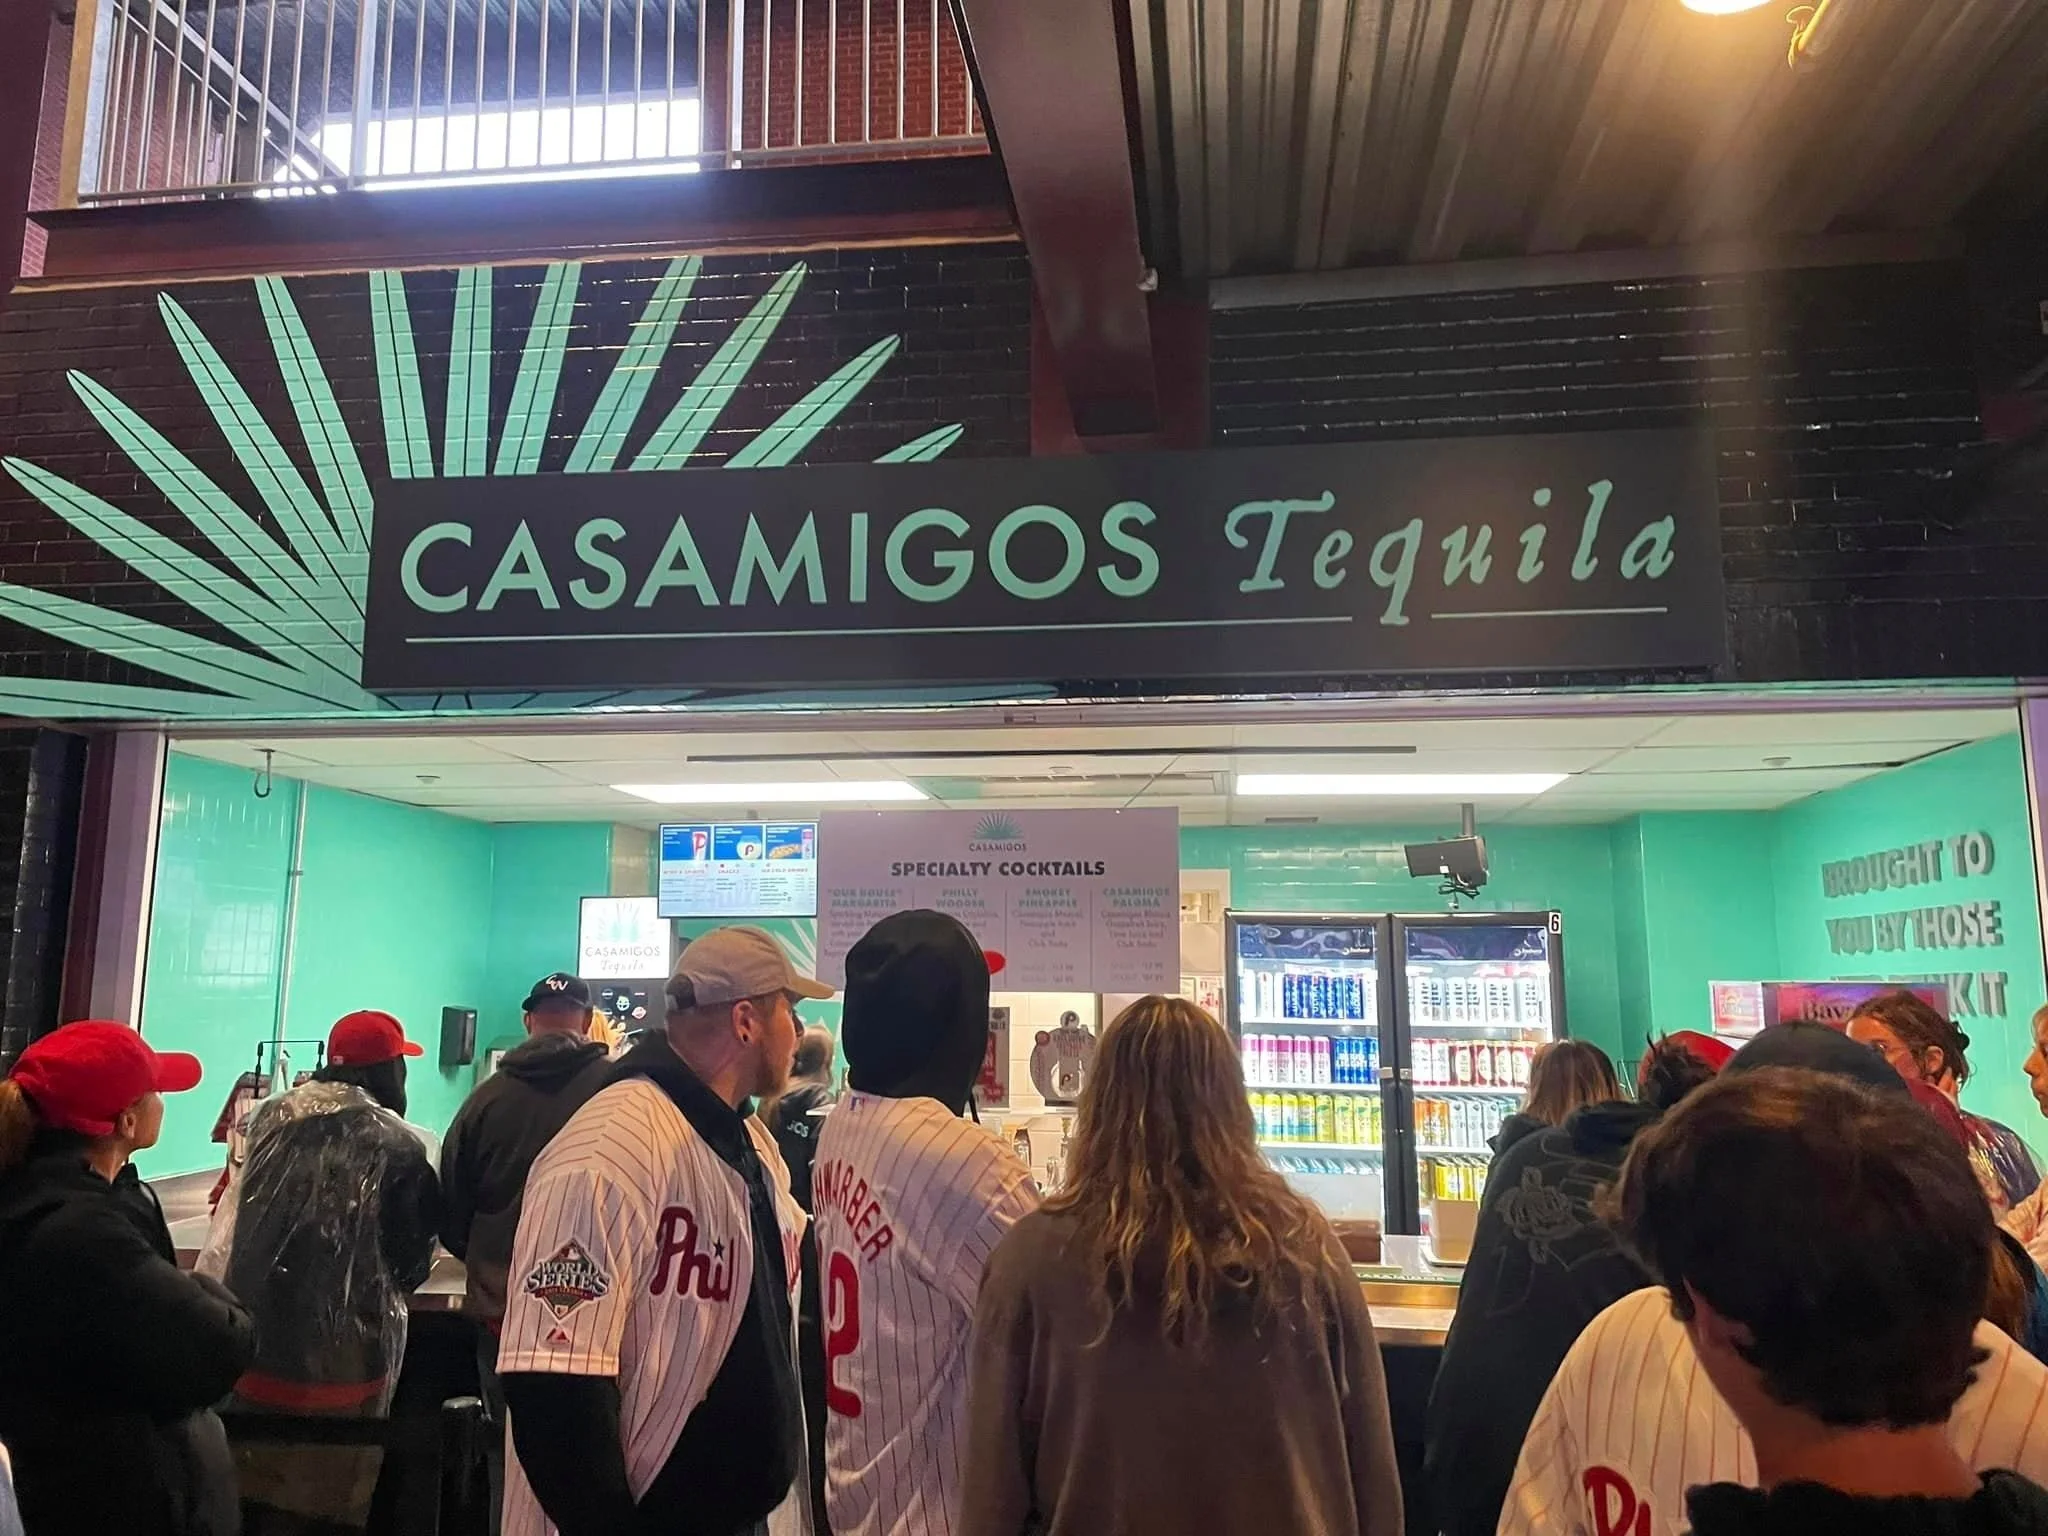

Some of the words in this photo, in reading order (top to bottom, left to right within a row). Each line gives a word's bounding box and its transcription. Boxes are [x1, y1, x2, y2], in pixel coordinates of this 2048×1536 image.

[399, 501, 1161, 614] CASAMIGOS
[1222, 478, 1677, 628] Tequila
[969, 843, 1027, 852] CASAMIGOS
[891, 862, 992, 877] SPECIALTY
[998, 861, 1105, 876] COCKTAILS
[1822, 840, 1943, 897] BROUGHT
[1947, 831, 1995, 877] TO
[1551, 914, 1559, 932] 6
[1825, 916, 1874, 955] YOU
[1874, 911, 1907, 952] BY
[1908, 900, 2004, 951] THOSE
[585, 946, 661, 957] CASAMIGOS
[814, 1159, 893, 1262] HWARBER
[540, 1260, 601, 1276] WORLD
[527, 1271, 608, 1295] SERIES
